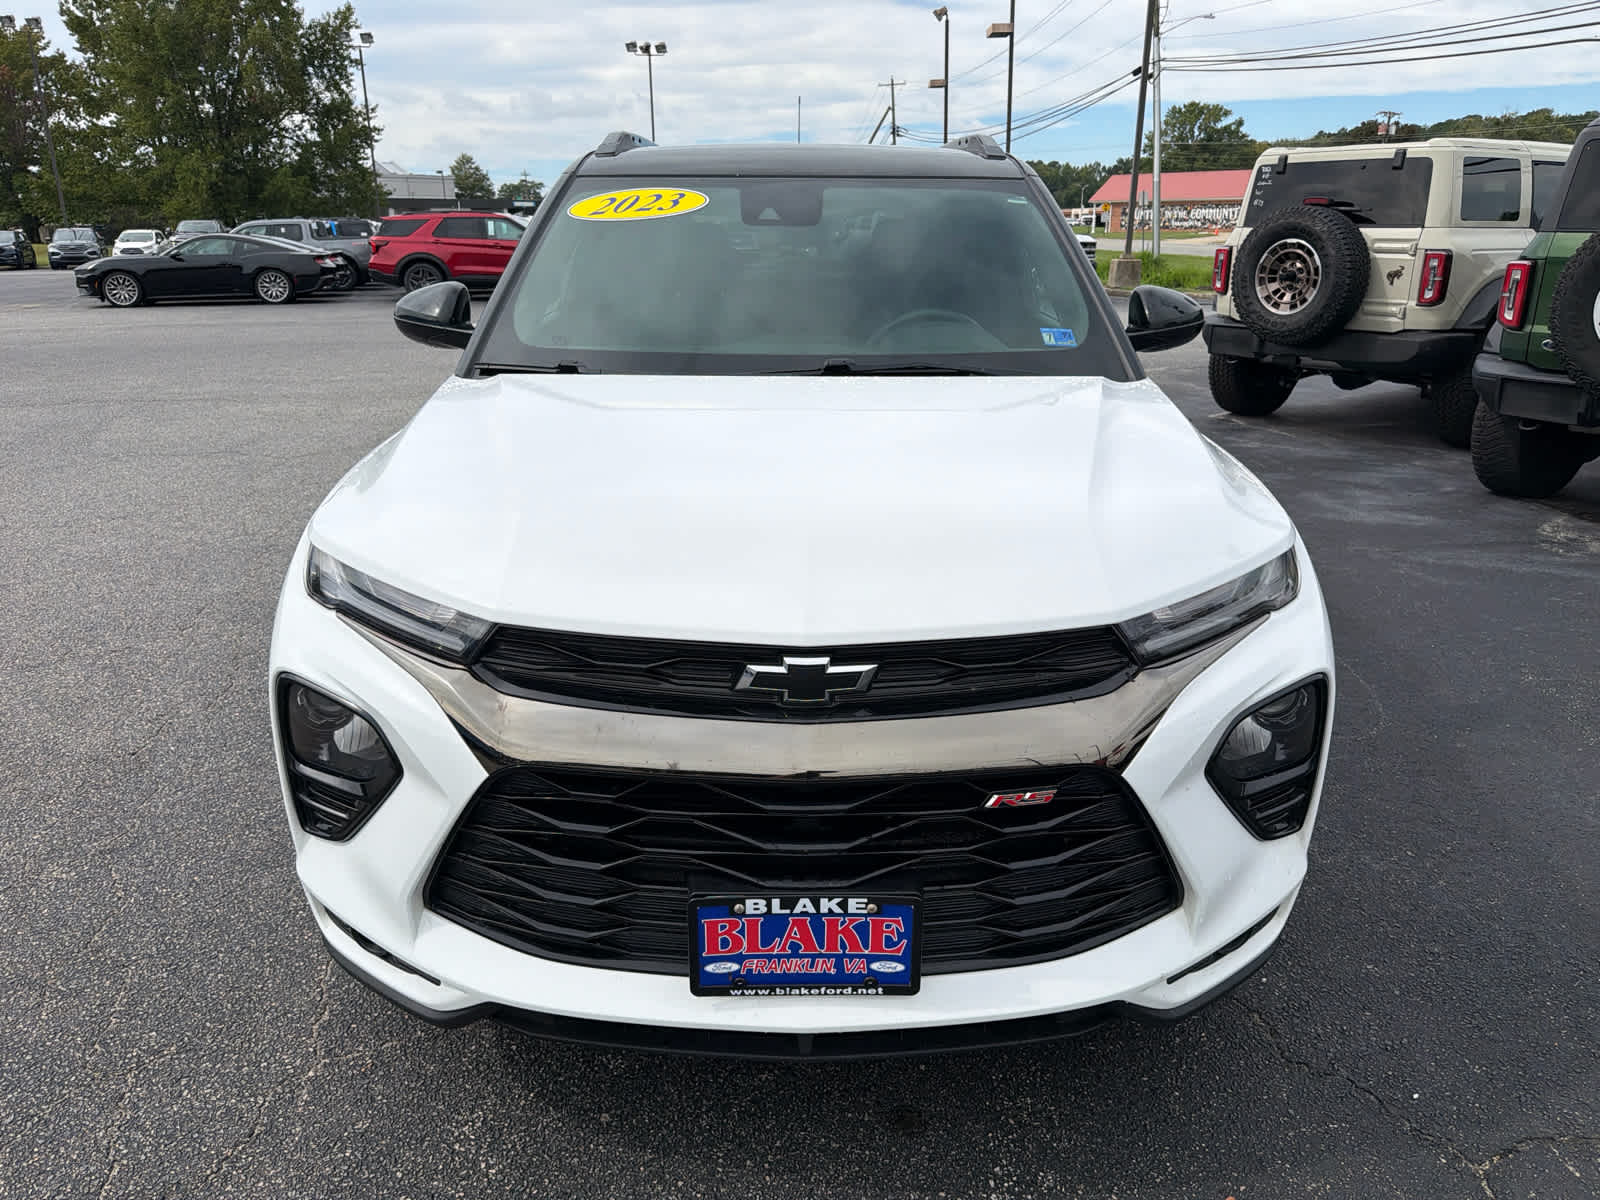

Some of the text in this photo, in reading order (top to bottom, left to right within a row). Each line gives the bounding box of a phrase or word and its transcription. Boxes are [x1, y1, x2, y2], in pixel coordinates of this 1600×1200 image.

[588, 192, 687, 217] 2023
[984, 789, 1058, 808] RS
[744, 898, 869, 915] BLAKE
[701, 916, 908, 957] BLAKE
[740, 958, 868, 975] FRANKLIN, VA
[729, 986, 884, 996] www.blakeford.net
